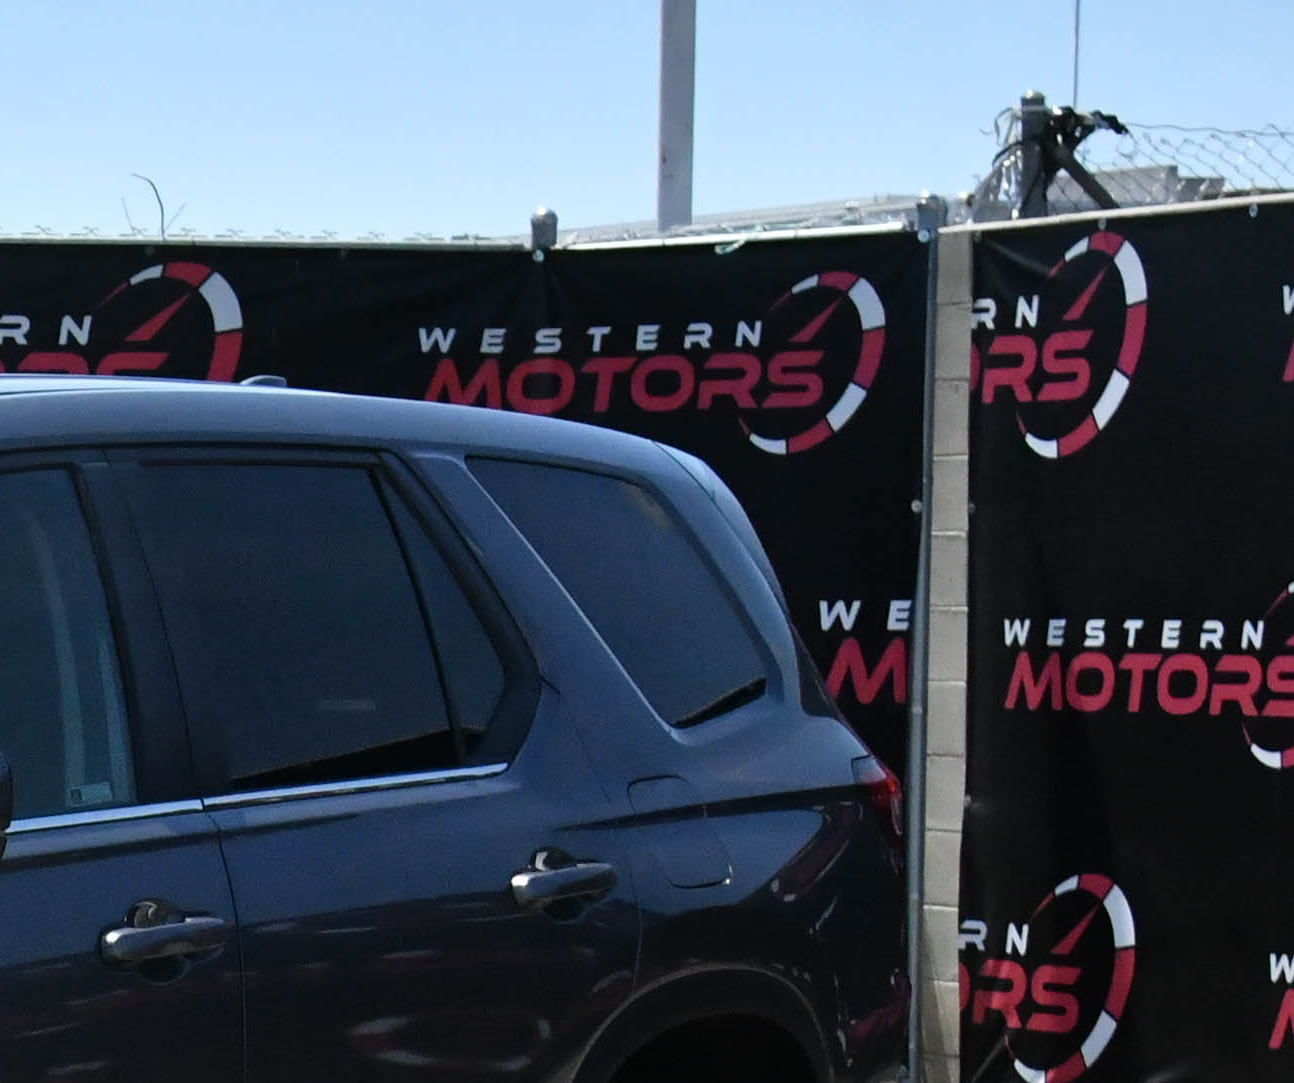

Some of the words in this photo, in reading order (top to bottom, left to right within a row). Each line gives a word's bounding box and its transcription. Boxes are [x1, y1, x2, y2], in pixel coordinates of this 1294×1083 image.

[419, 320, 762, 353] WESTERN
[425, 350, 824, 415] MOTORS
[970, 329, 1093, 404] RS
[1004, 618, 1264, 650] WESTERN
[959, 920, 1029, 956] RN
[959, 958, 1081, 1033] RS
